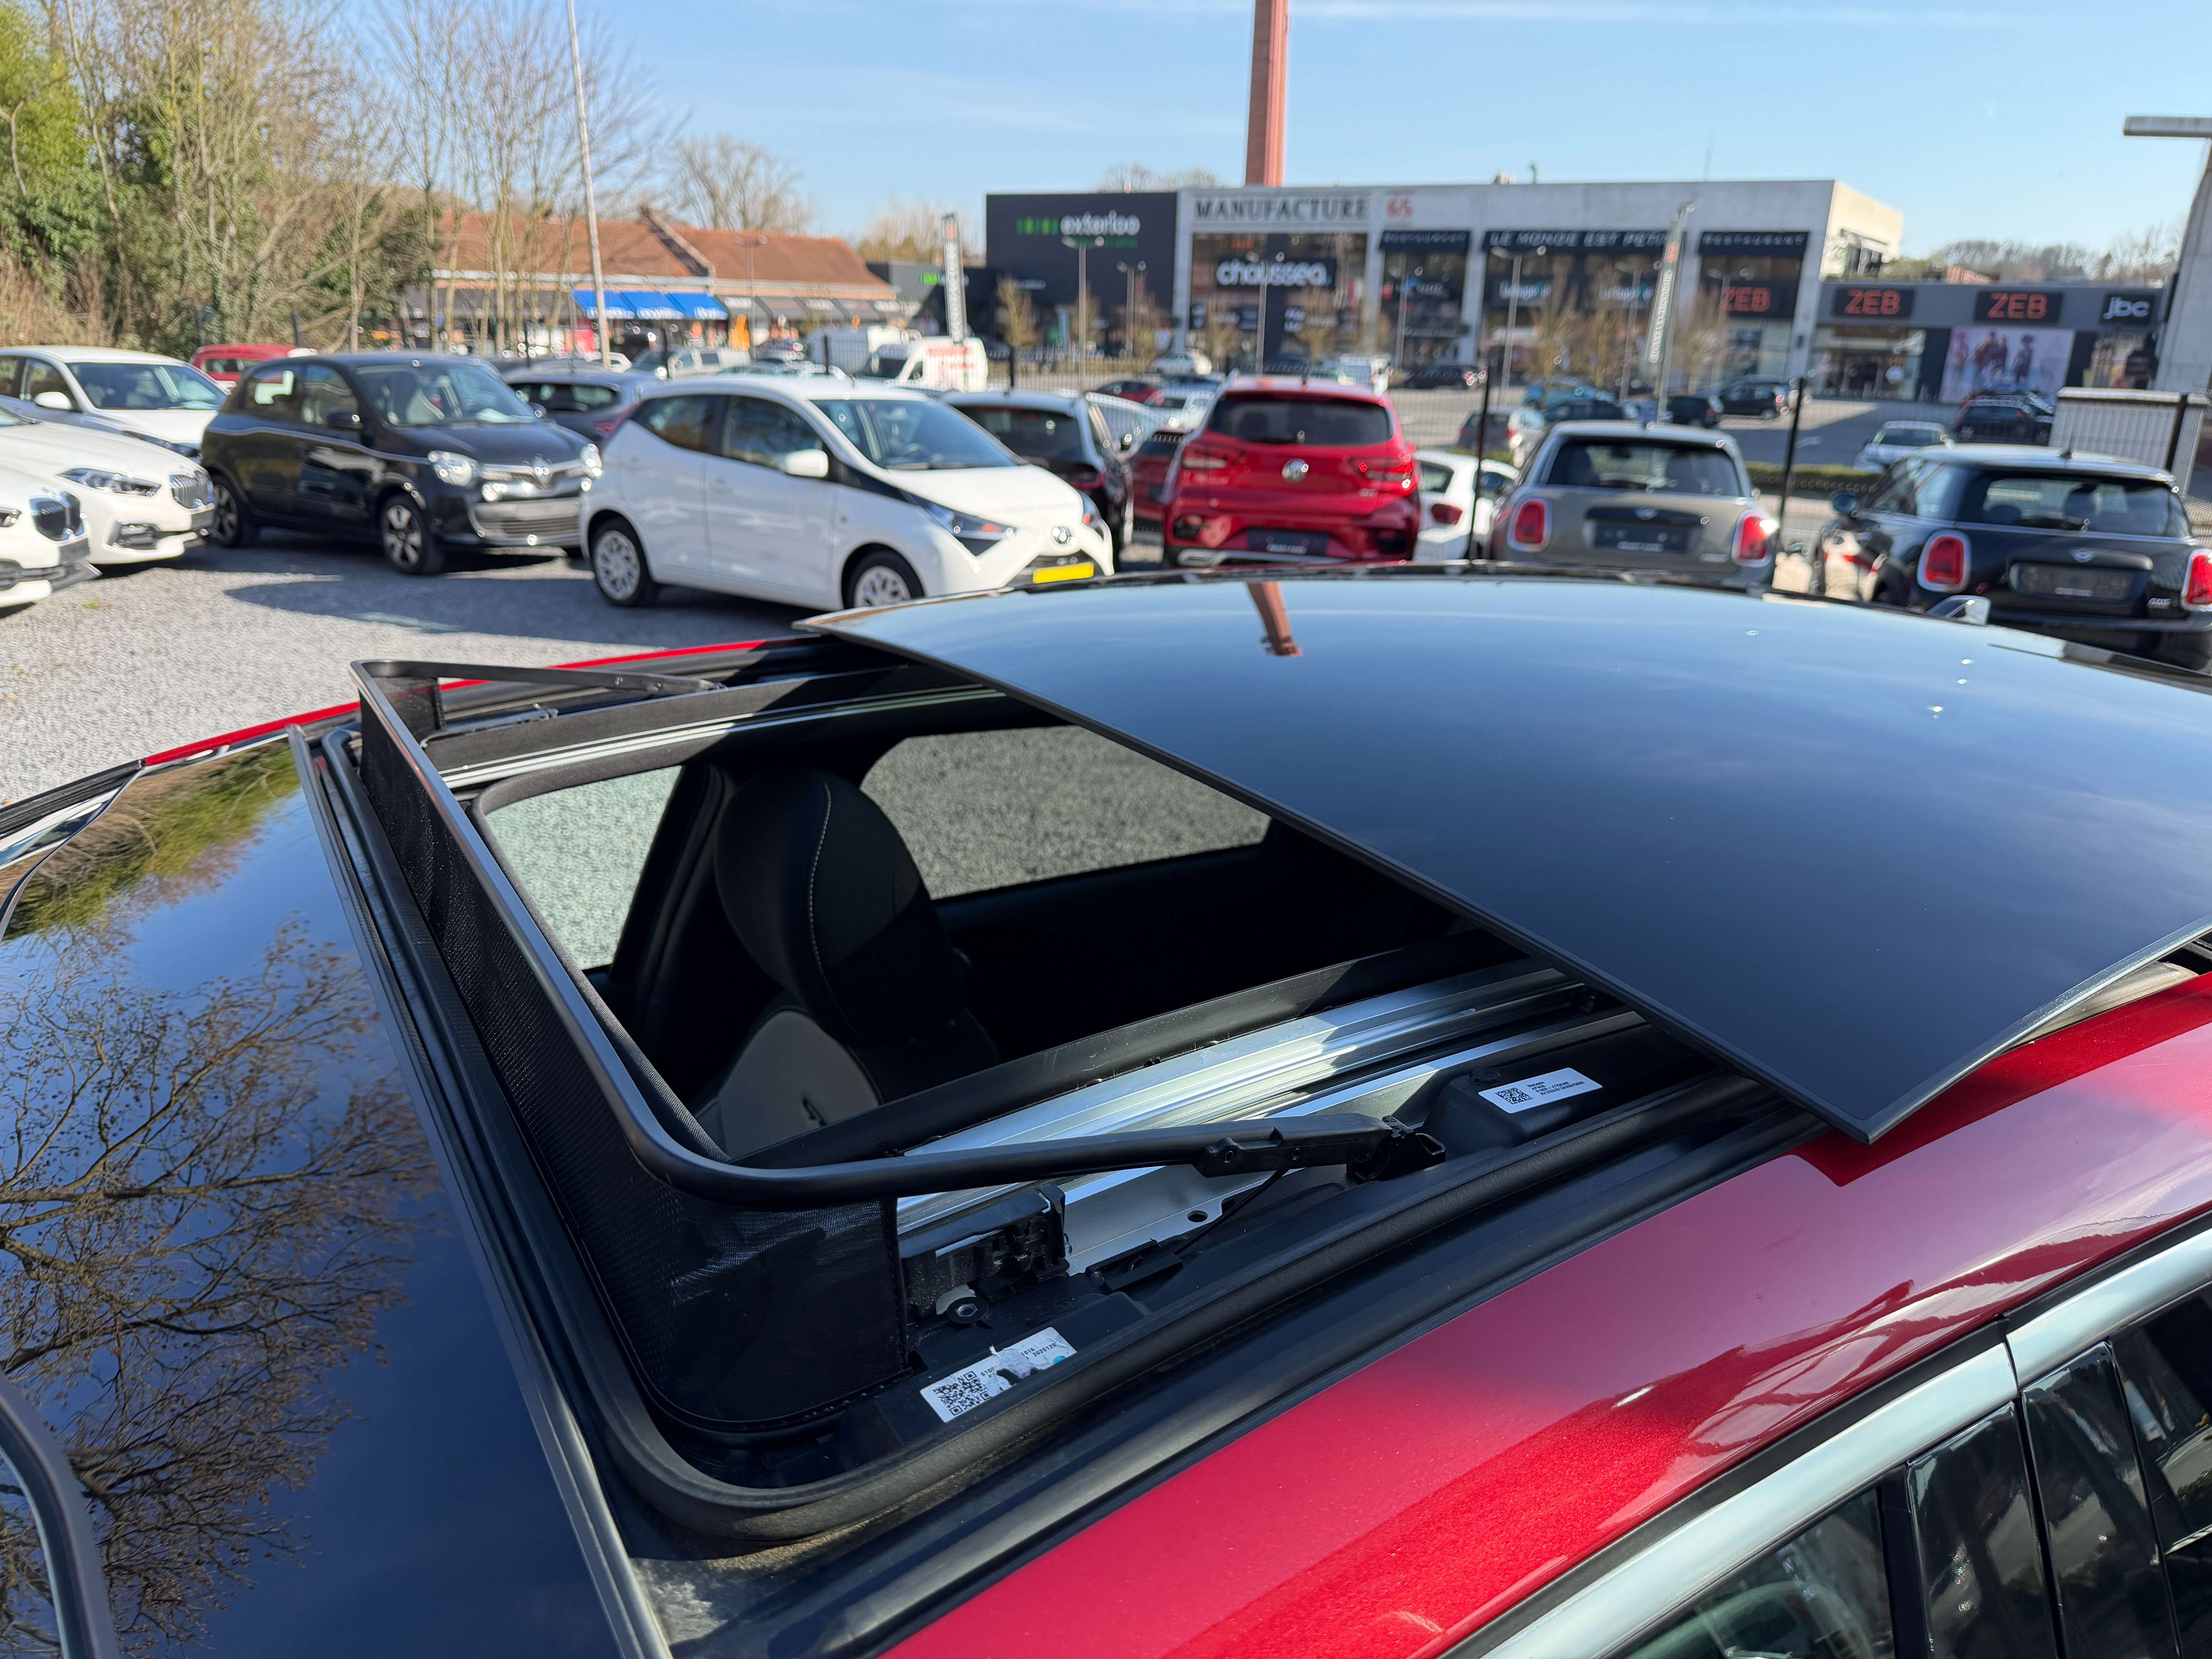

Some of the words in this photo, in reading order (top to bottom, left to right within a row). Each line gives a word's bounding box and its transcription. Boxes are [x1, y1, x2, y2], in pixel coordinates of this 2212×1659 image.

[1195, 197, 1370, 220] MANUFACTURE
[1721, 287, 1771, 312] ZEB
[1844, 289, 1901, 315] ZEB
[1988, 292, 2047, 319] ZEB
[1032, 1340, 1056, 1357] 2020120
